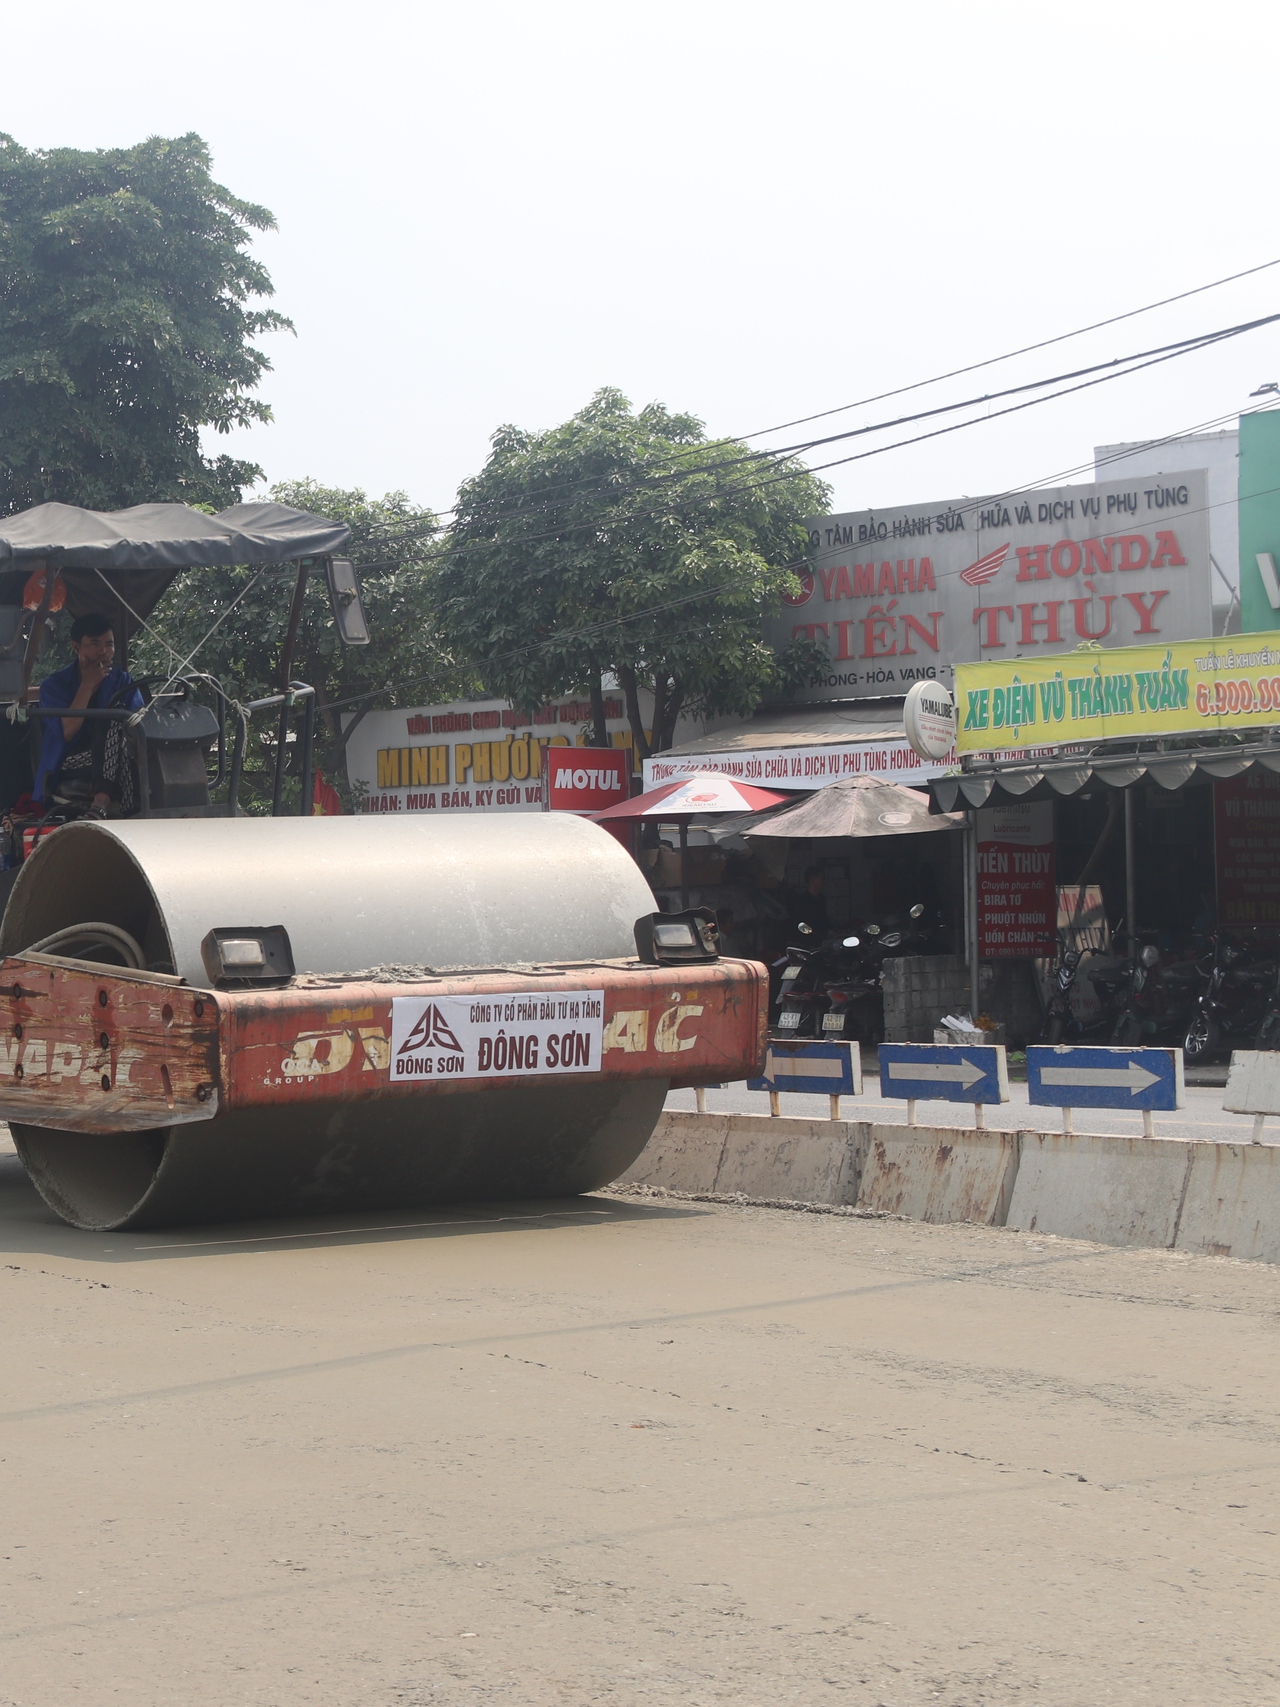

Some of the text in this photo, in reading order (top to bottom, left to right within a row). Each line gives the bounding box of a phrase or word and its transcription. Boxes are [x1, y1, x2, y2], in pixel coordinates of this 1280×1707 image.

[825, 523, 853, 546] TÂM
[859, 516, 887, 542] BẢO
[1015, 500, 1033, 524] VÀ
[1038, 500, 1074, 524] DỊCH
[1080, 496, 1100, 520] VỤ
[1106, 491, 1137, 515] PHỤ
[1144, 484, 1188, 510] TÙNG
[1015, 529, 1187, 582] HONDA
[820, 556, 937, 601] YAMAHA
[792, 580, 1170, 662] TIẾN THÙY
[1236, 645, 1274, 668] KHUYẾN
[899, 666, 937, 681] VANG
[963, 648, 1189, 740] XE ĐIỆN VŨ THÀNH TUẤN
[920, 698, 953, 719] YAMALUBE
[473, 710, 500, 730] GIAO
[376, 745, 450, 789] MINH
[651, 763, 678, 782] TRUNG
[765, 754, 788, 779] CHỮA
[791, 752, 803, 777] VÀ
[804, 755, 826, 780] DỊCH
[828, 754, 839, 779] VỤ
[864, 747, 887, 772] TÙNG
[890, 748, 921, 770] HONDA
[554, 768, 621, 790] MOTUL
[406, 792, 436, 810] MUA
[441, 787, 473, 810] BÁN,
[475, 786, 494, 807] KÝ
[496, 782, 521, 806] GỬI
[993, 824, 1031, 833] Lubricants
[976, 846, 1050, 873] TIẾN THÙY
[981, 880, 1008, 892] Chuyên
[1011, 881, 1030, 891] phục
[984, 894, 1007, 906] BIRA
[985, 912, 1015, 927] PHUỘT
[1018, 911, 1046, 924] NHÚN
[985, 928, 1006, 943] UỐN
[985, 948, 997, 956] ĐT:
[470, 1001, 491, 1023] CÔNG
[493, 1004, 503, 1022] TY
[518, 996, 538, 1021] PHẦN
[540, 996, 556, 1020] ĐẦU
[558, 1001, 568, 1019] TƯ
[569, 1001, 580, 1023] HẠ
[477, 1029, 591, 1072] ĐÔNG SƠN
[396, 1055, 464, 1075] ĐÔNG SƠN
[263, 1075, 315, 1085] GROUP
